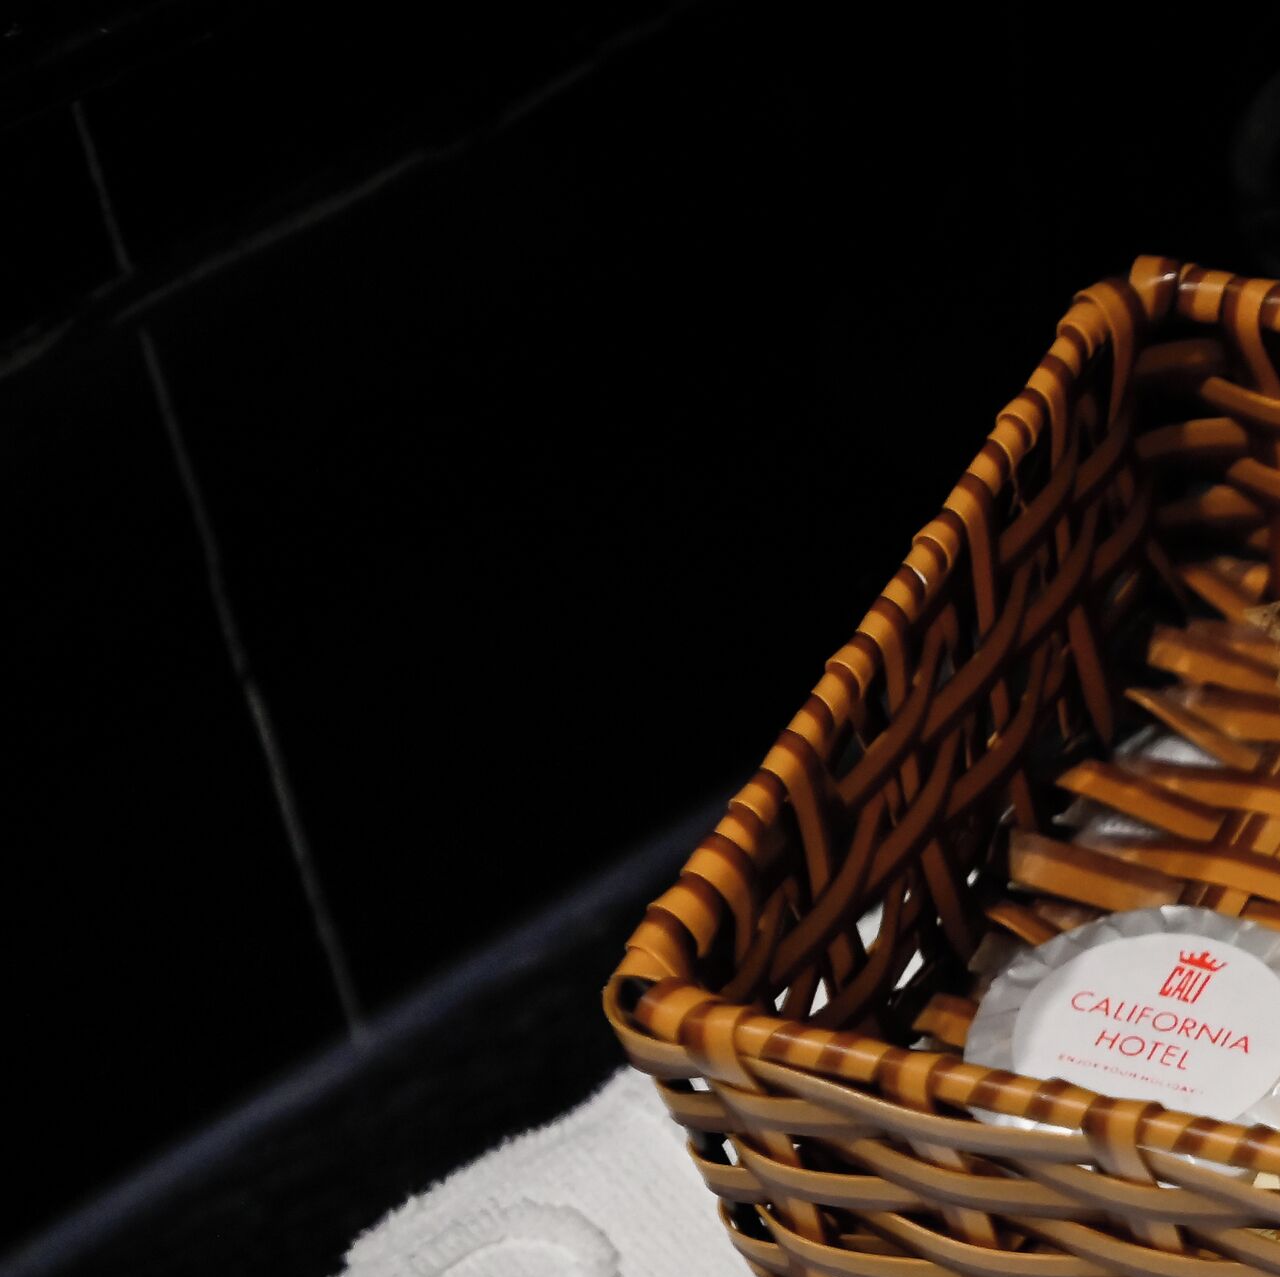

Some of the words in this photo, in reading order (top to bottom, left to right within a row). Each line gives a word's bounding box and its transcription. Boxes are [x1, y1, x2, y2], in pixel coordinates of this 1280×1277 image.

[1158, 965, 1213, 1005] CALI
[1070, 990, 1250, 1054] CALIFORNIA
[1094, 1029, 1191, 1071] HOTEL
